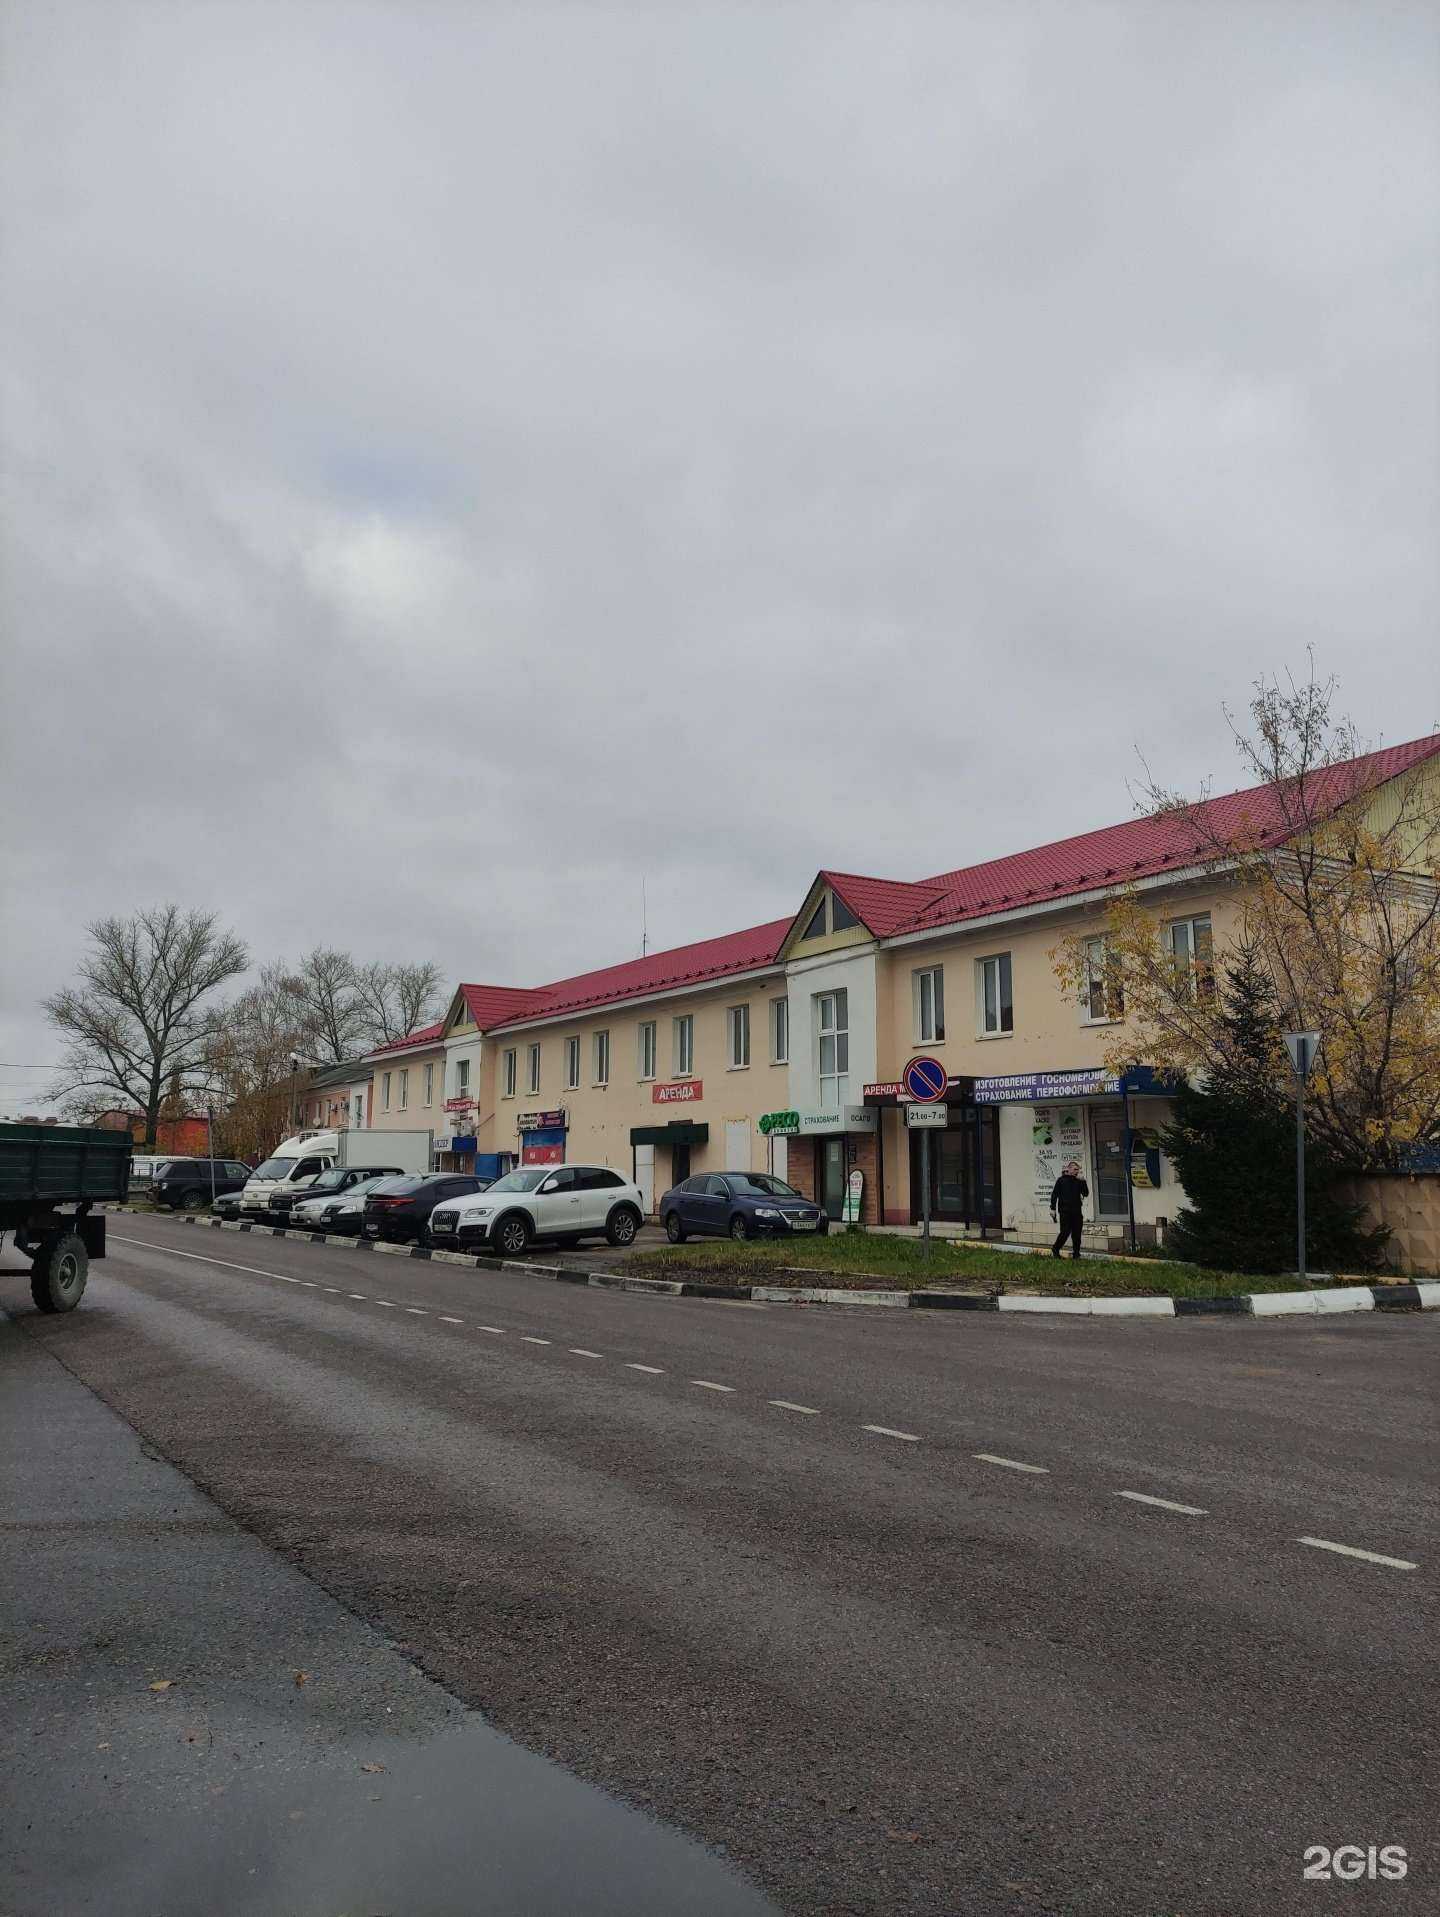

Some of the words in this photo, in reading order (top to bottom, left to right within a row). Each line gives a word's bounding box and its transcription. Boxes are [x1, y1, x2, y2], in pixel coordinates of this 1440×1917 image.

[975, 1075, 1037, 1089] ИЗГОТОВЛЕНИЕ
[659, 1086, 694, 1100] АРЕНДА
[864, 1085, 898, 1095] АРЕНДА
[975, 1088, 1033, 1102] СТРАХОВАНИЕ
[1036, 1081, 1120, 1097] ПЕРЕОФОРМЛНИЕ
[804, 1115, 840, 1125] СТРАХОВАНИЕ
